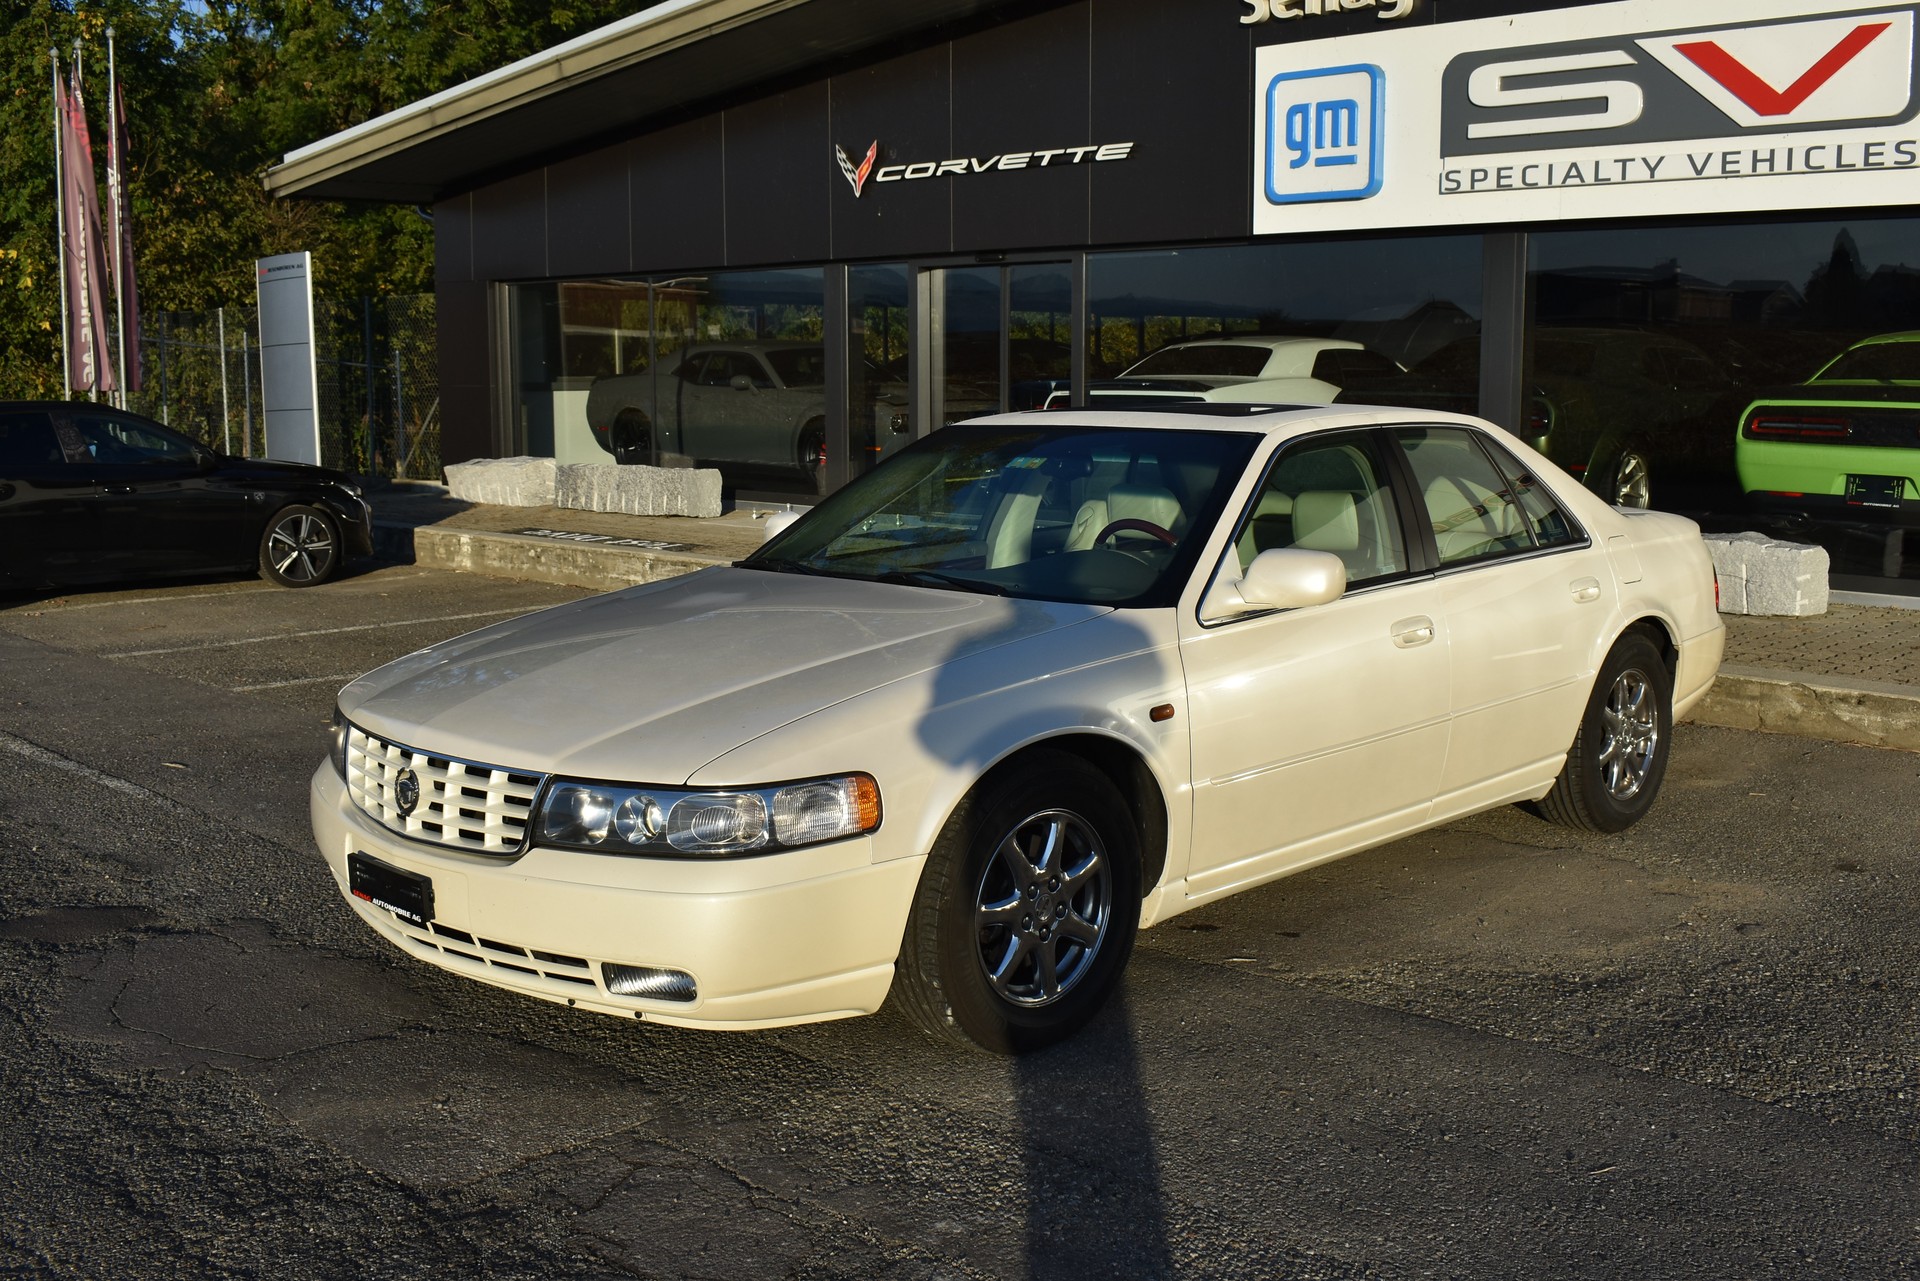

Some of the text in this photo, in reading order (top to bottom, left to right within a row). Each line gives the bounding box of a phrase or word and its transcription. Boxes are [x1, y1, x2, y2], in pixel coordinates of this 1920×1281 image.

[1468, 22, 1893, 139] SV
[1286, 99, 1358, 169] gm
[876, 142, 1134, 182] CORVETTE
[1444, 140, 1917, 192] SPECIALTY VEHICLES
[372, 898, 411, 918] AUTOMOBILE
[411, 914, 422, 923] AG
